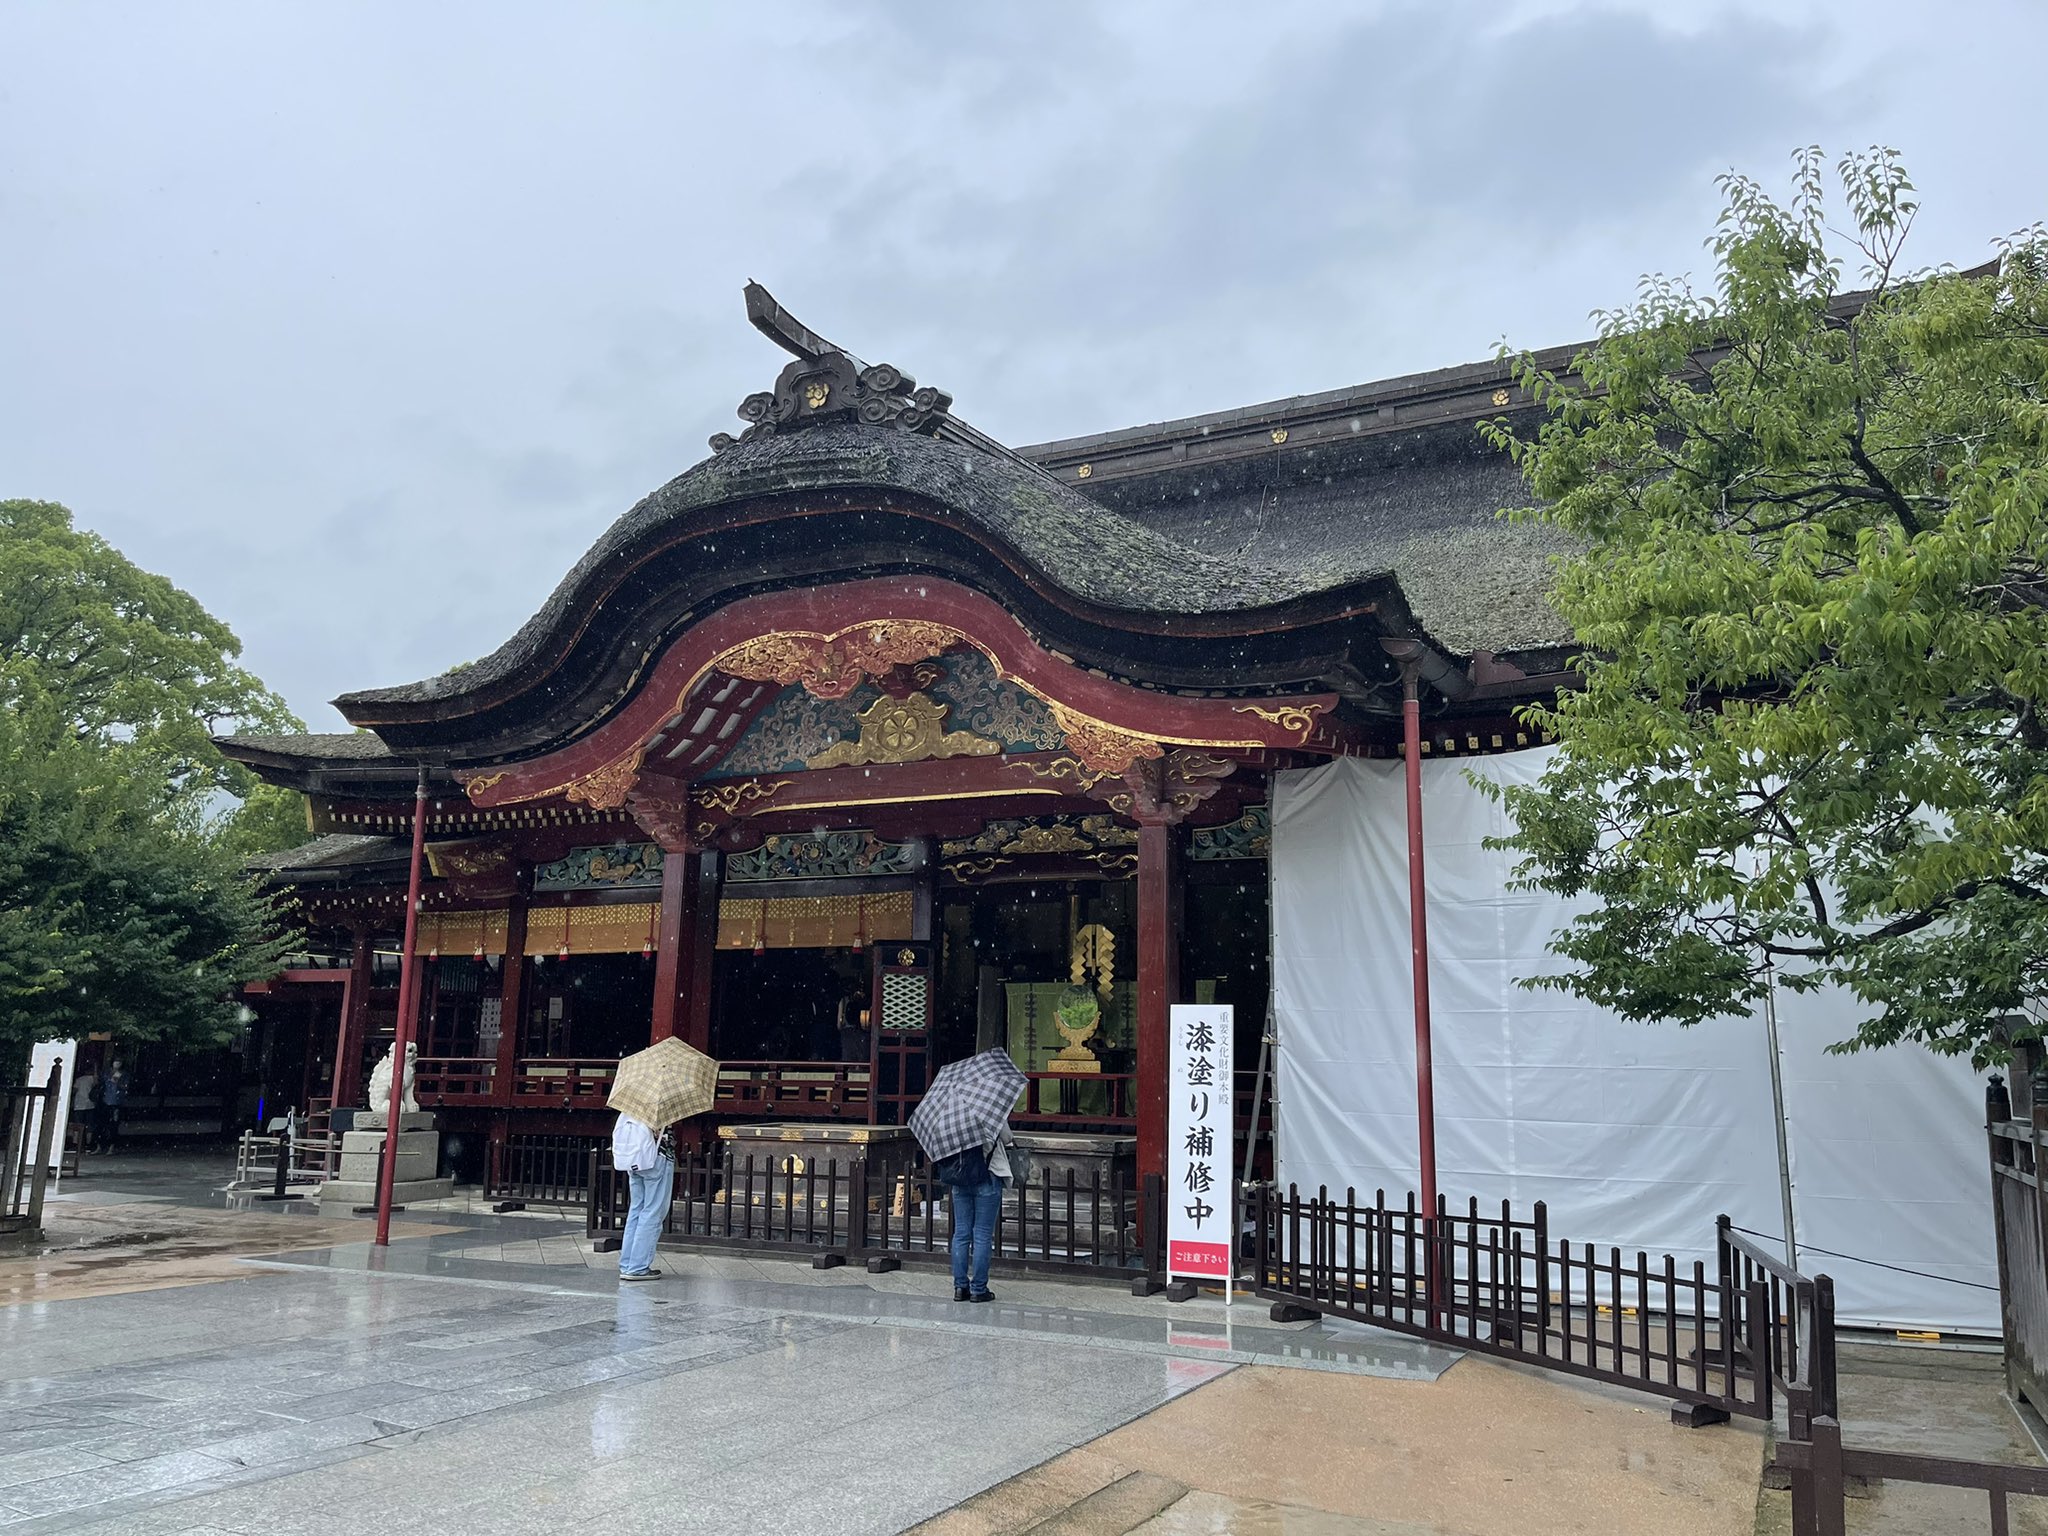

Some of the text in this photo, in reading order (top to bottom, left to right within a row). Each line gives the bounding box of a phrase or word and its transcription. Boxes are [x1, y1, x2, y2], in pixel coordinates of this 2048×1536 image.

[1183, 1021, 1216, 1231] 漆塗り補修中
[1175, 1252, 1227, 1264] ご注意下さい
